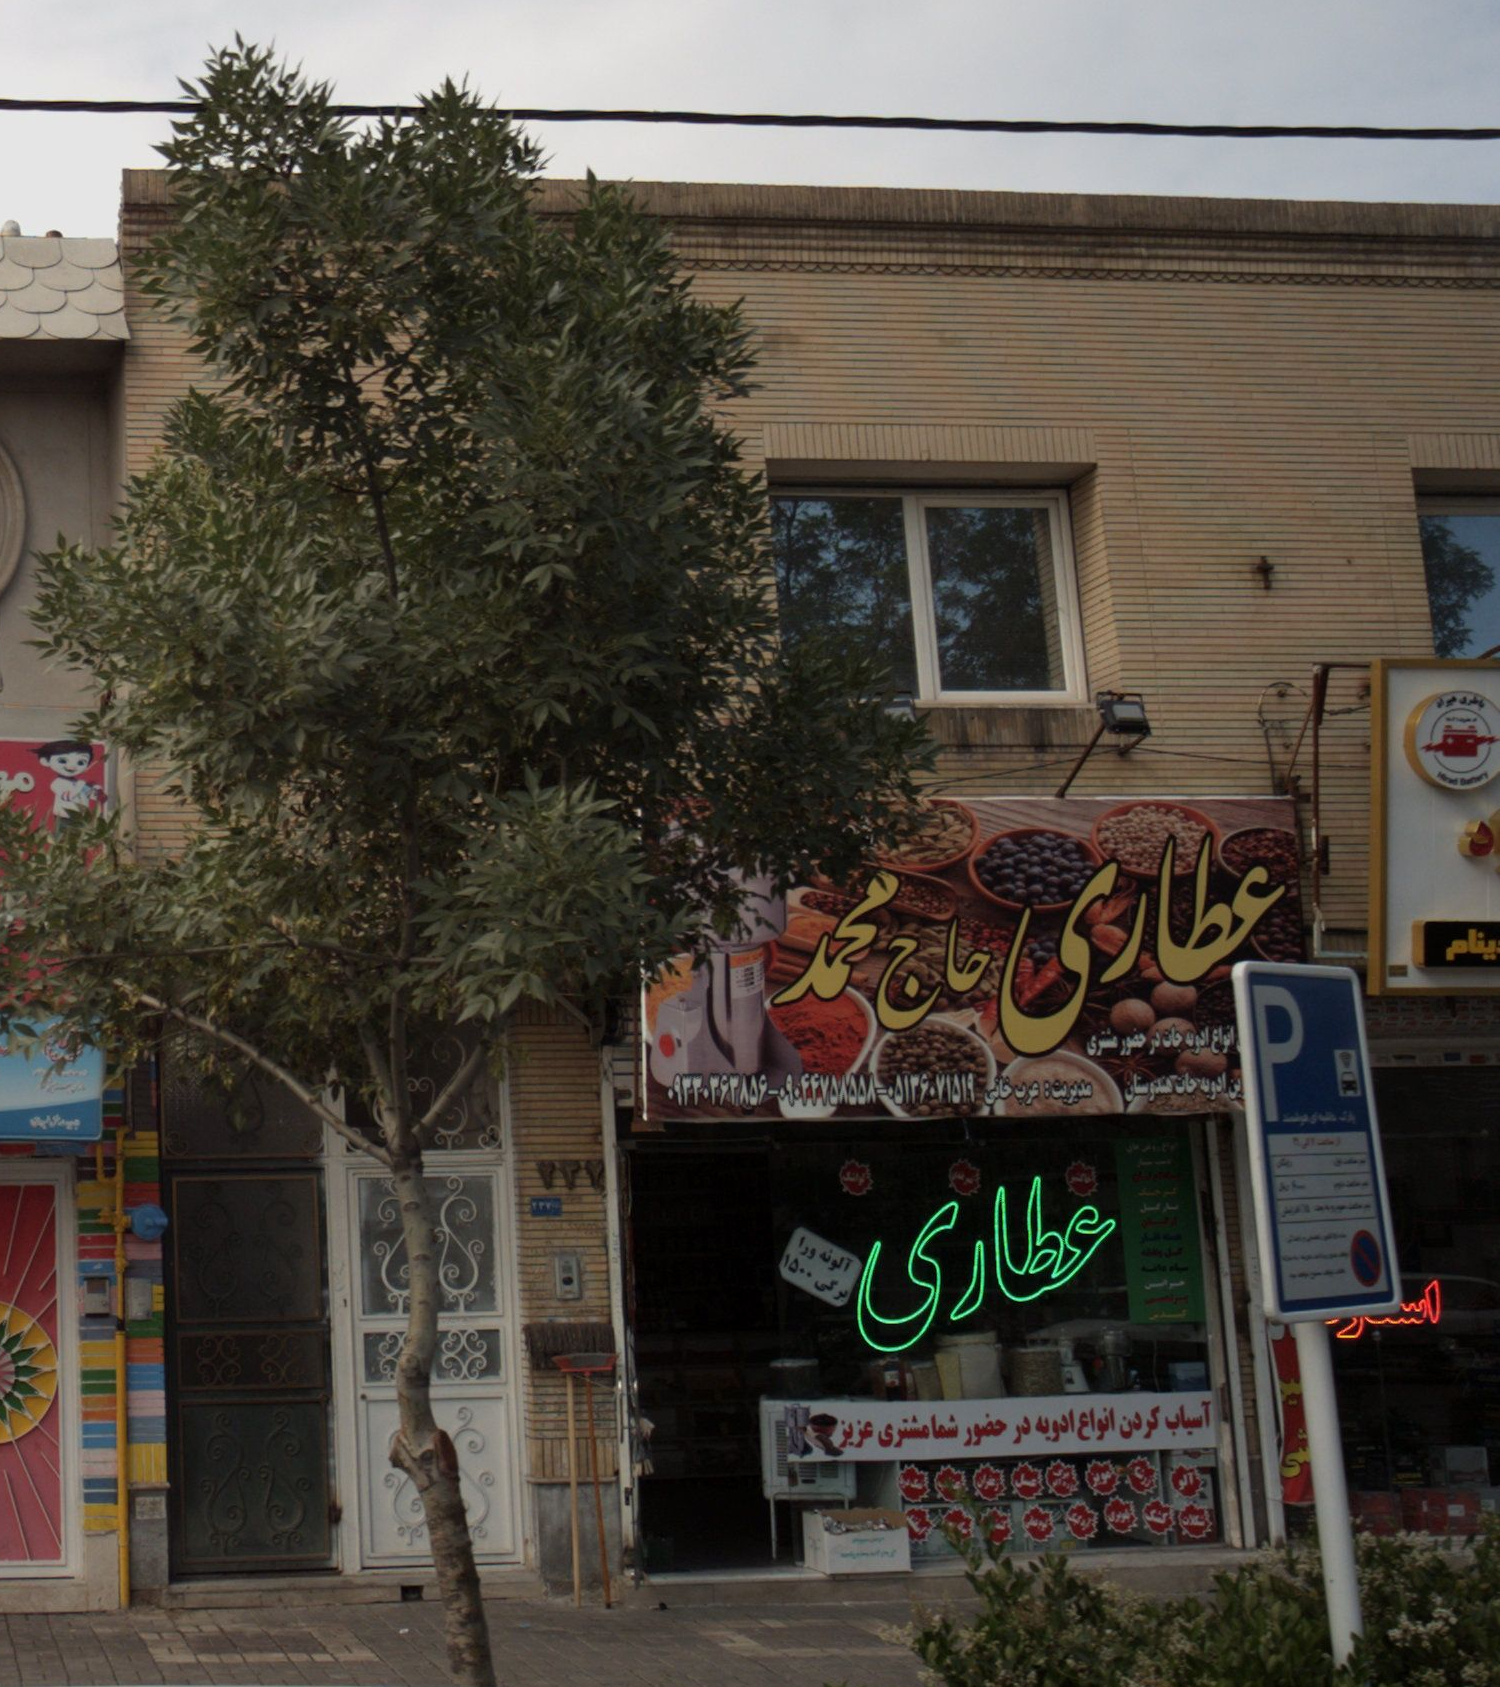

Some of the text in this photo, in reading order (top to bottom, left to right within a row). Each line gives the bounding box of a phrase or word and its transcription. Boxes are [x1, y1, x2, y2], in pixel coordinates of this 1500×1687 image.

[772, 833, 1287, 1059] عطاری حاج محمد
[1086, 1027, 1119, 1056] مشتری
[1119, 1027, 1146, 1056] حضور
[1148, 1031, 1160, 1055] در
[1162, 1026, 1182, 1053] جات
[1185, 1026, 1210, 1055] ادویه
[1211, 1025, 1235, 1055] انواع
[1252, 984, 1304, 1122] P
[1014, 1080, 1040, 1106] عرب
[1124, 1073, 1174, 1102] هندوستان
[856, 1173, 1117, 1353] عطاری
[838, 1401, 1212, 1448] آسیاب کردن انواع ادویه در حضور شما مشتری عزیز
